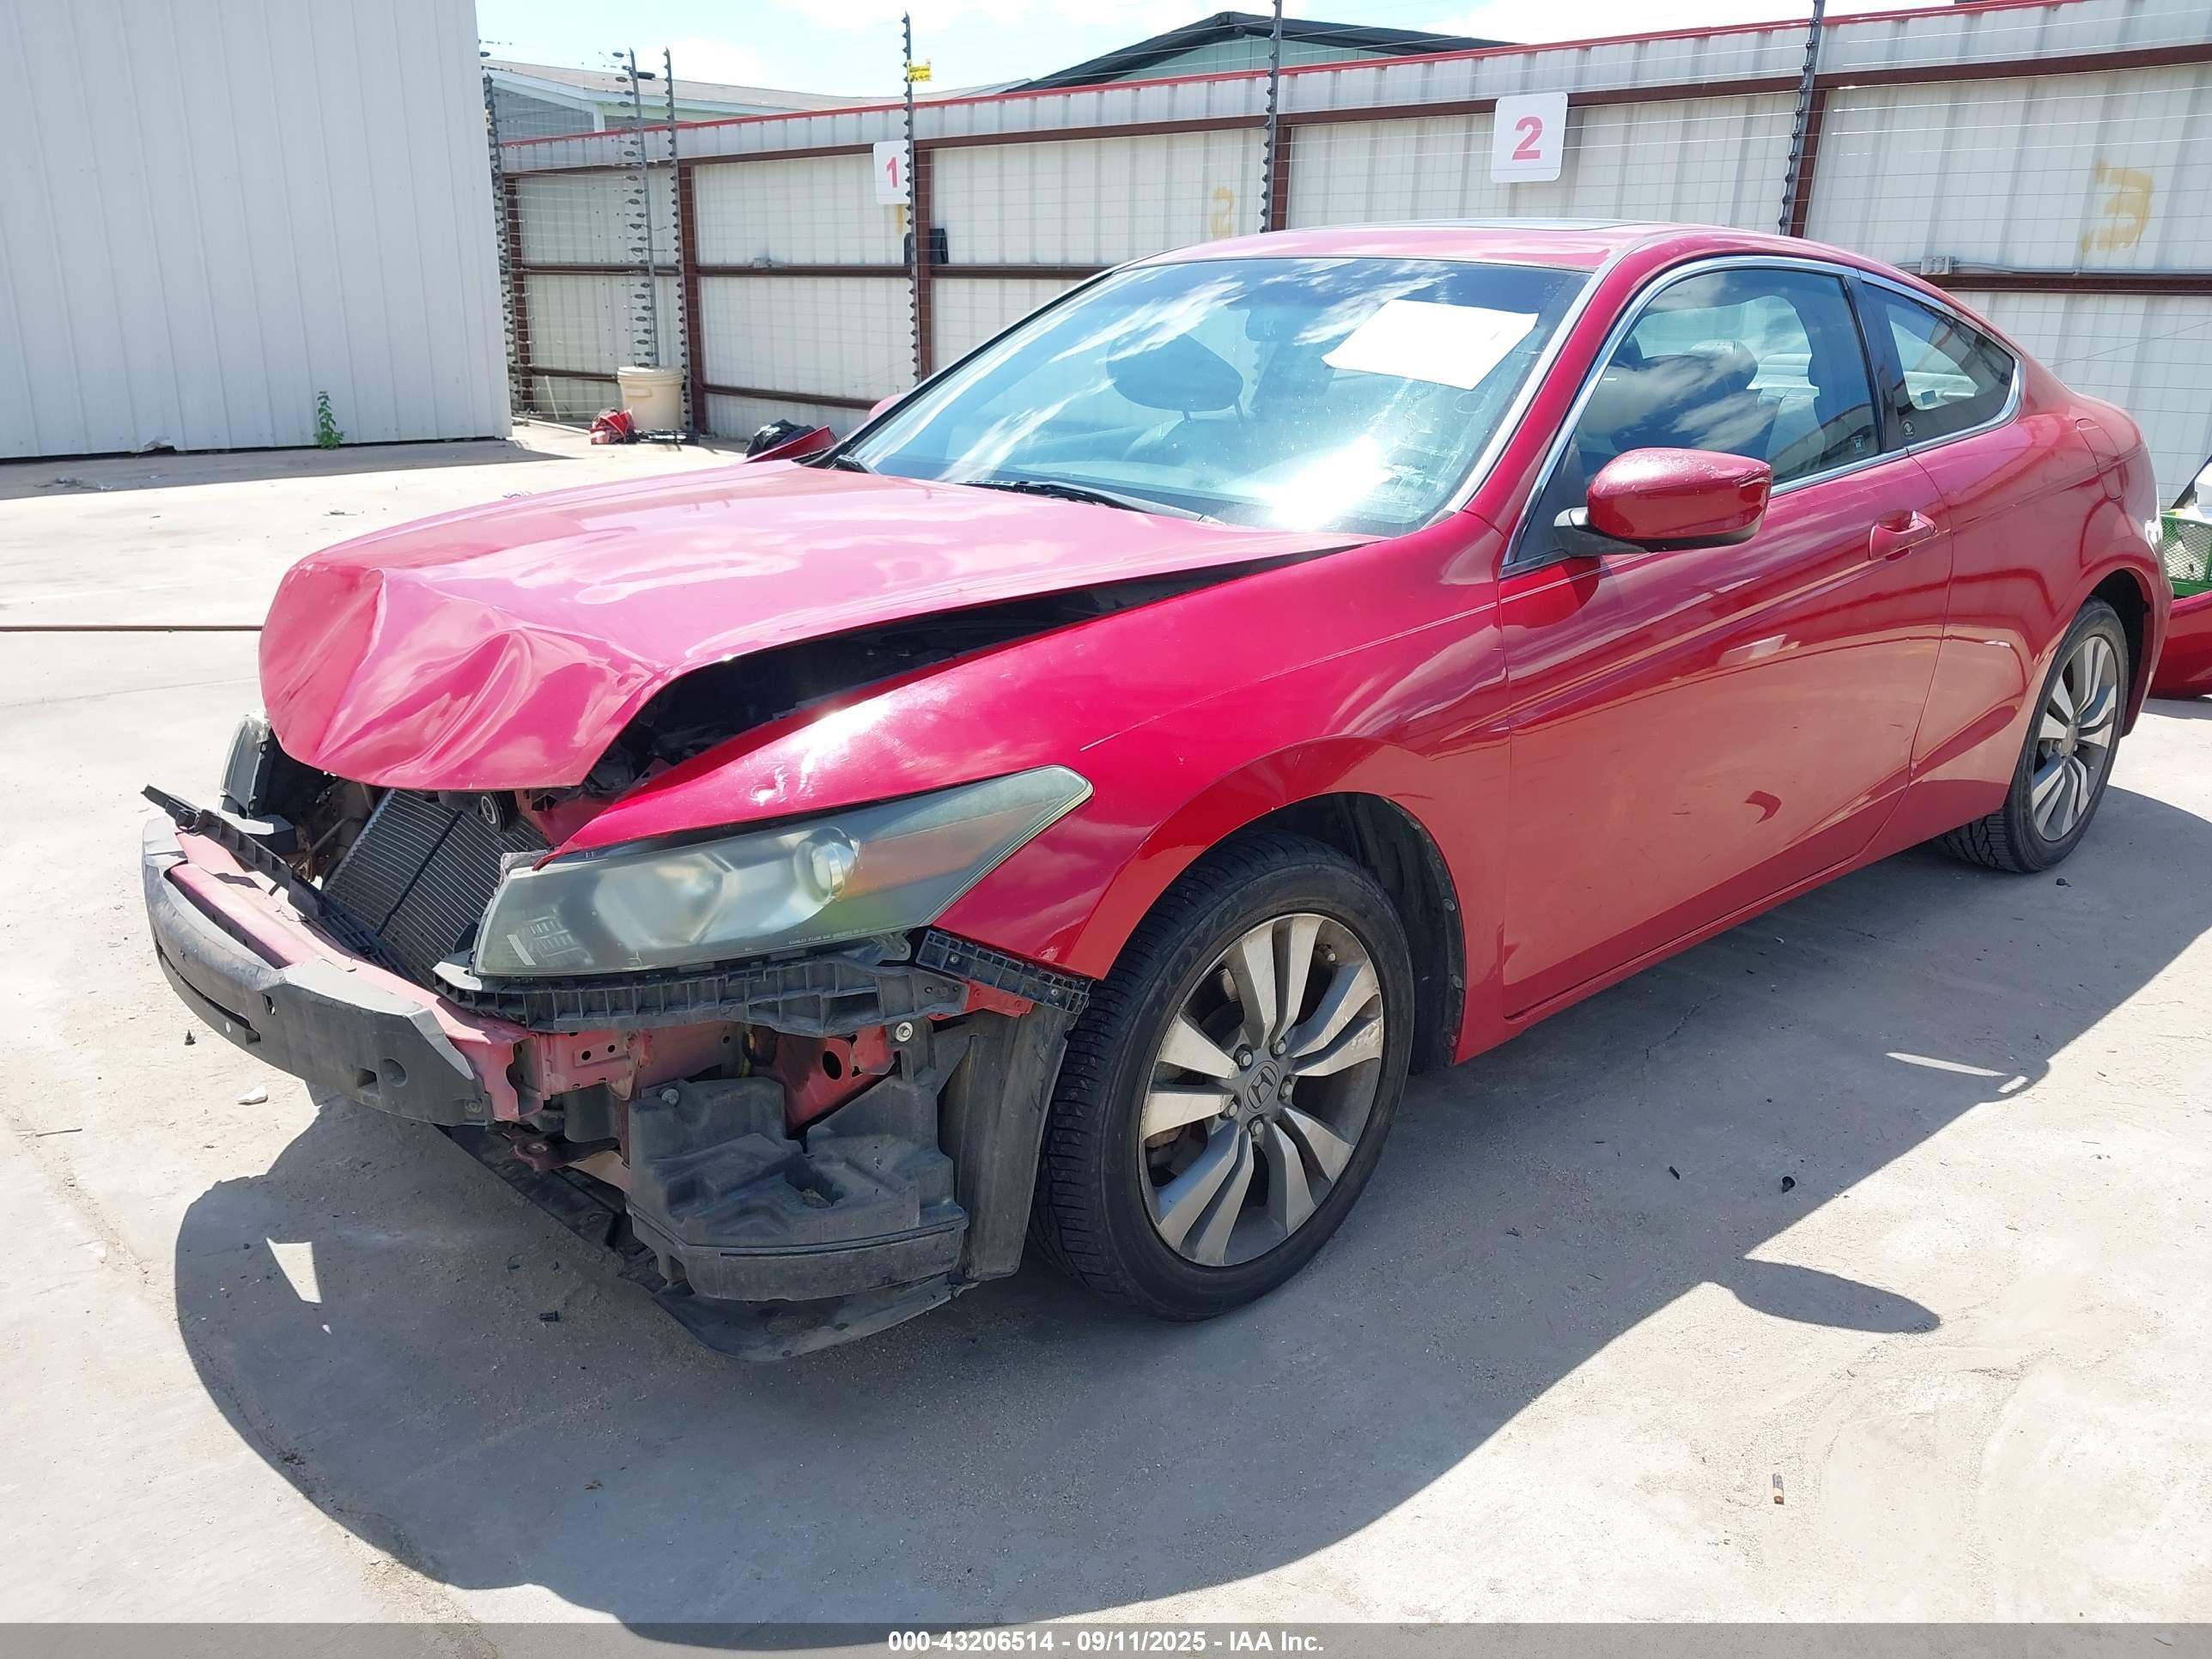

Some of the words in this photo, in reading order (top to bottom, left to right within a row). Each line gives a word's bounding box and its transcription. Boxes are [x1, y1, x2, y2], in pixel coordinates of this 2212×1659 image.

[1511, 116, 1543, 161] 2
[886, 156, 898, 188] 1
[2081, 164, 2154, 250] 3
